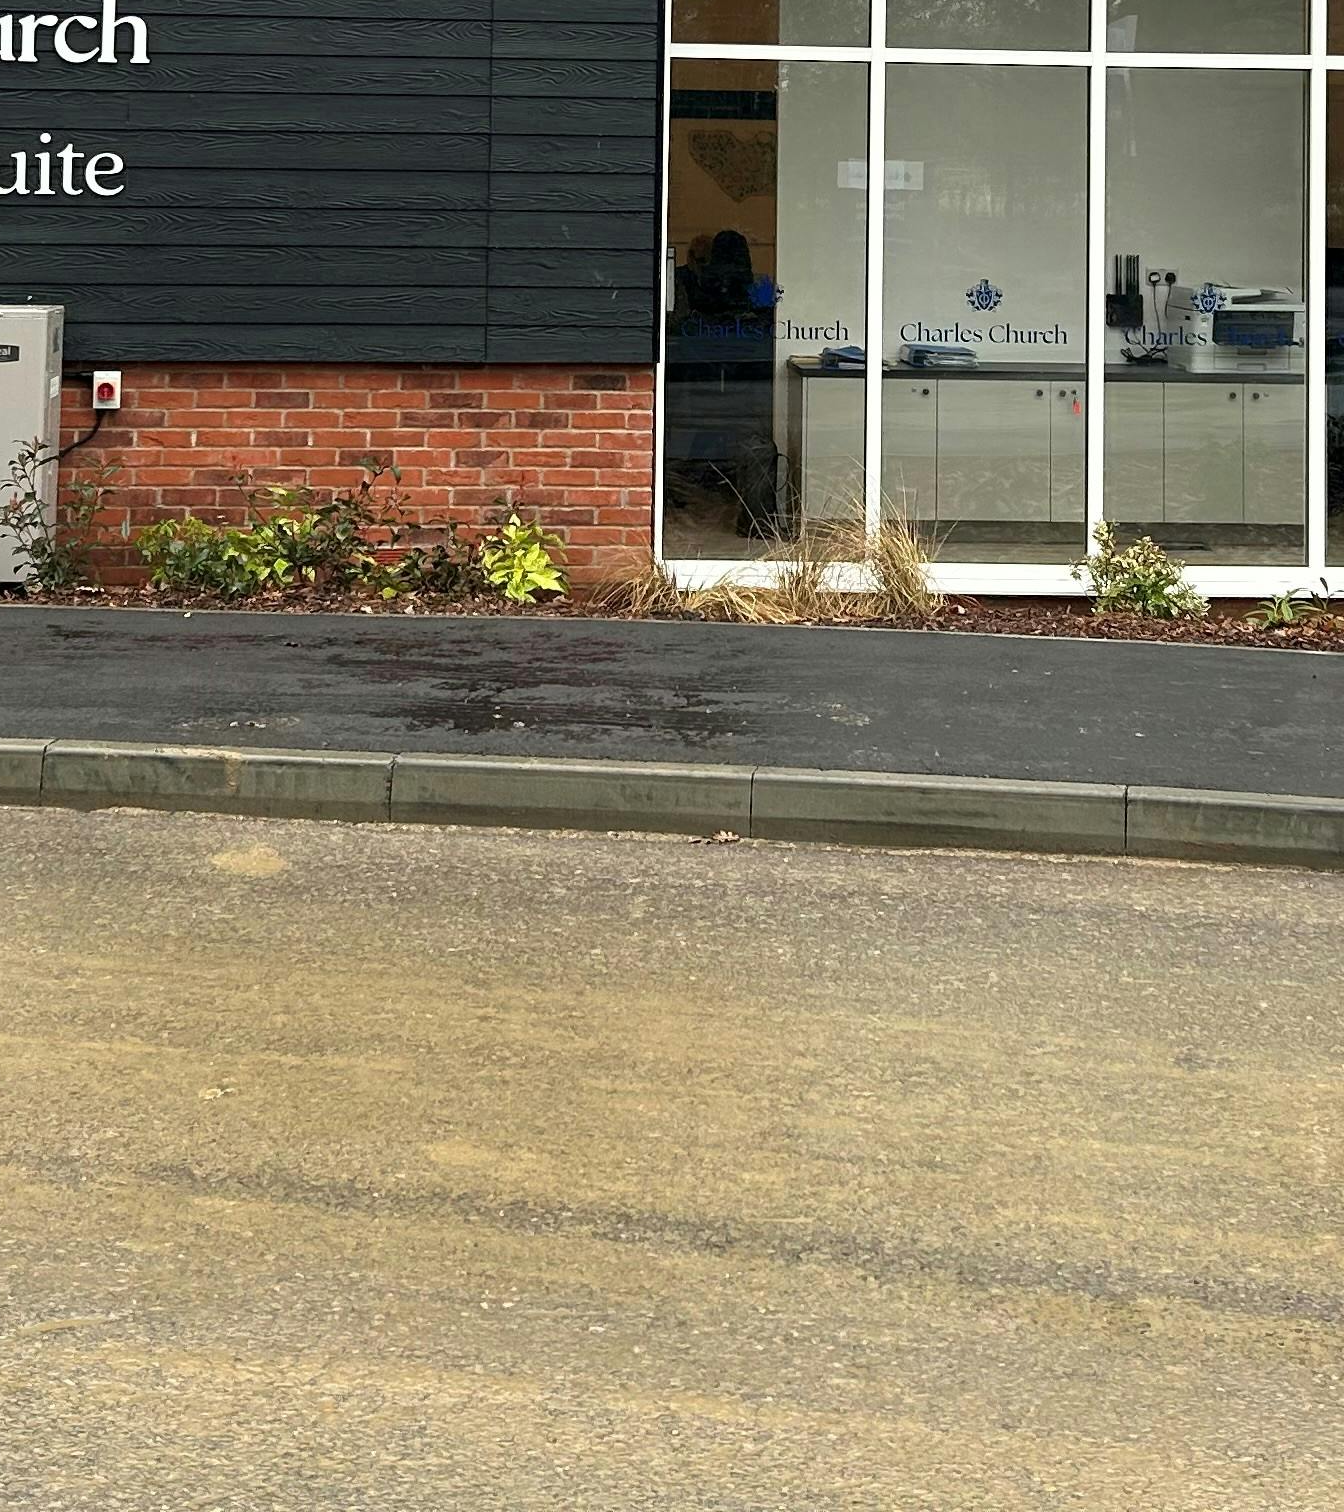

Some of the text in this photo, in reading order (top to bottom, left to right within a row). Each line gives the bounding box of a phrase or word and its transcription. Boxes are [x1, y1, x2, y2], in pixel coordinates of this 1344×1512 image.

[770, 320, 849, 341] Church
[899, 321, 1068, 345] Charles Church
[1123, 326, 1208, 346] Charles
